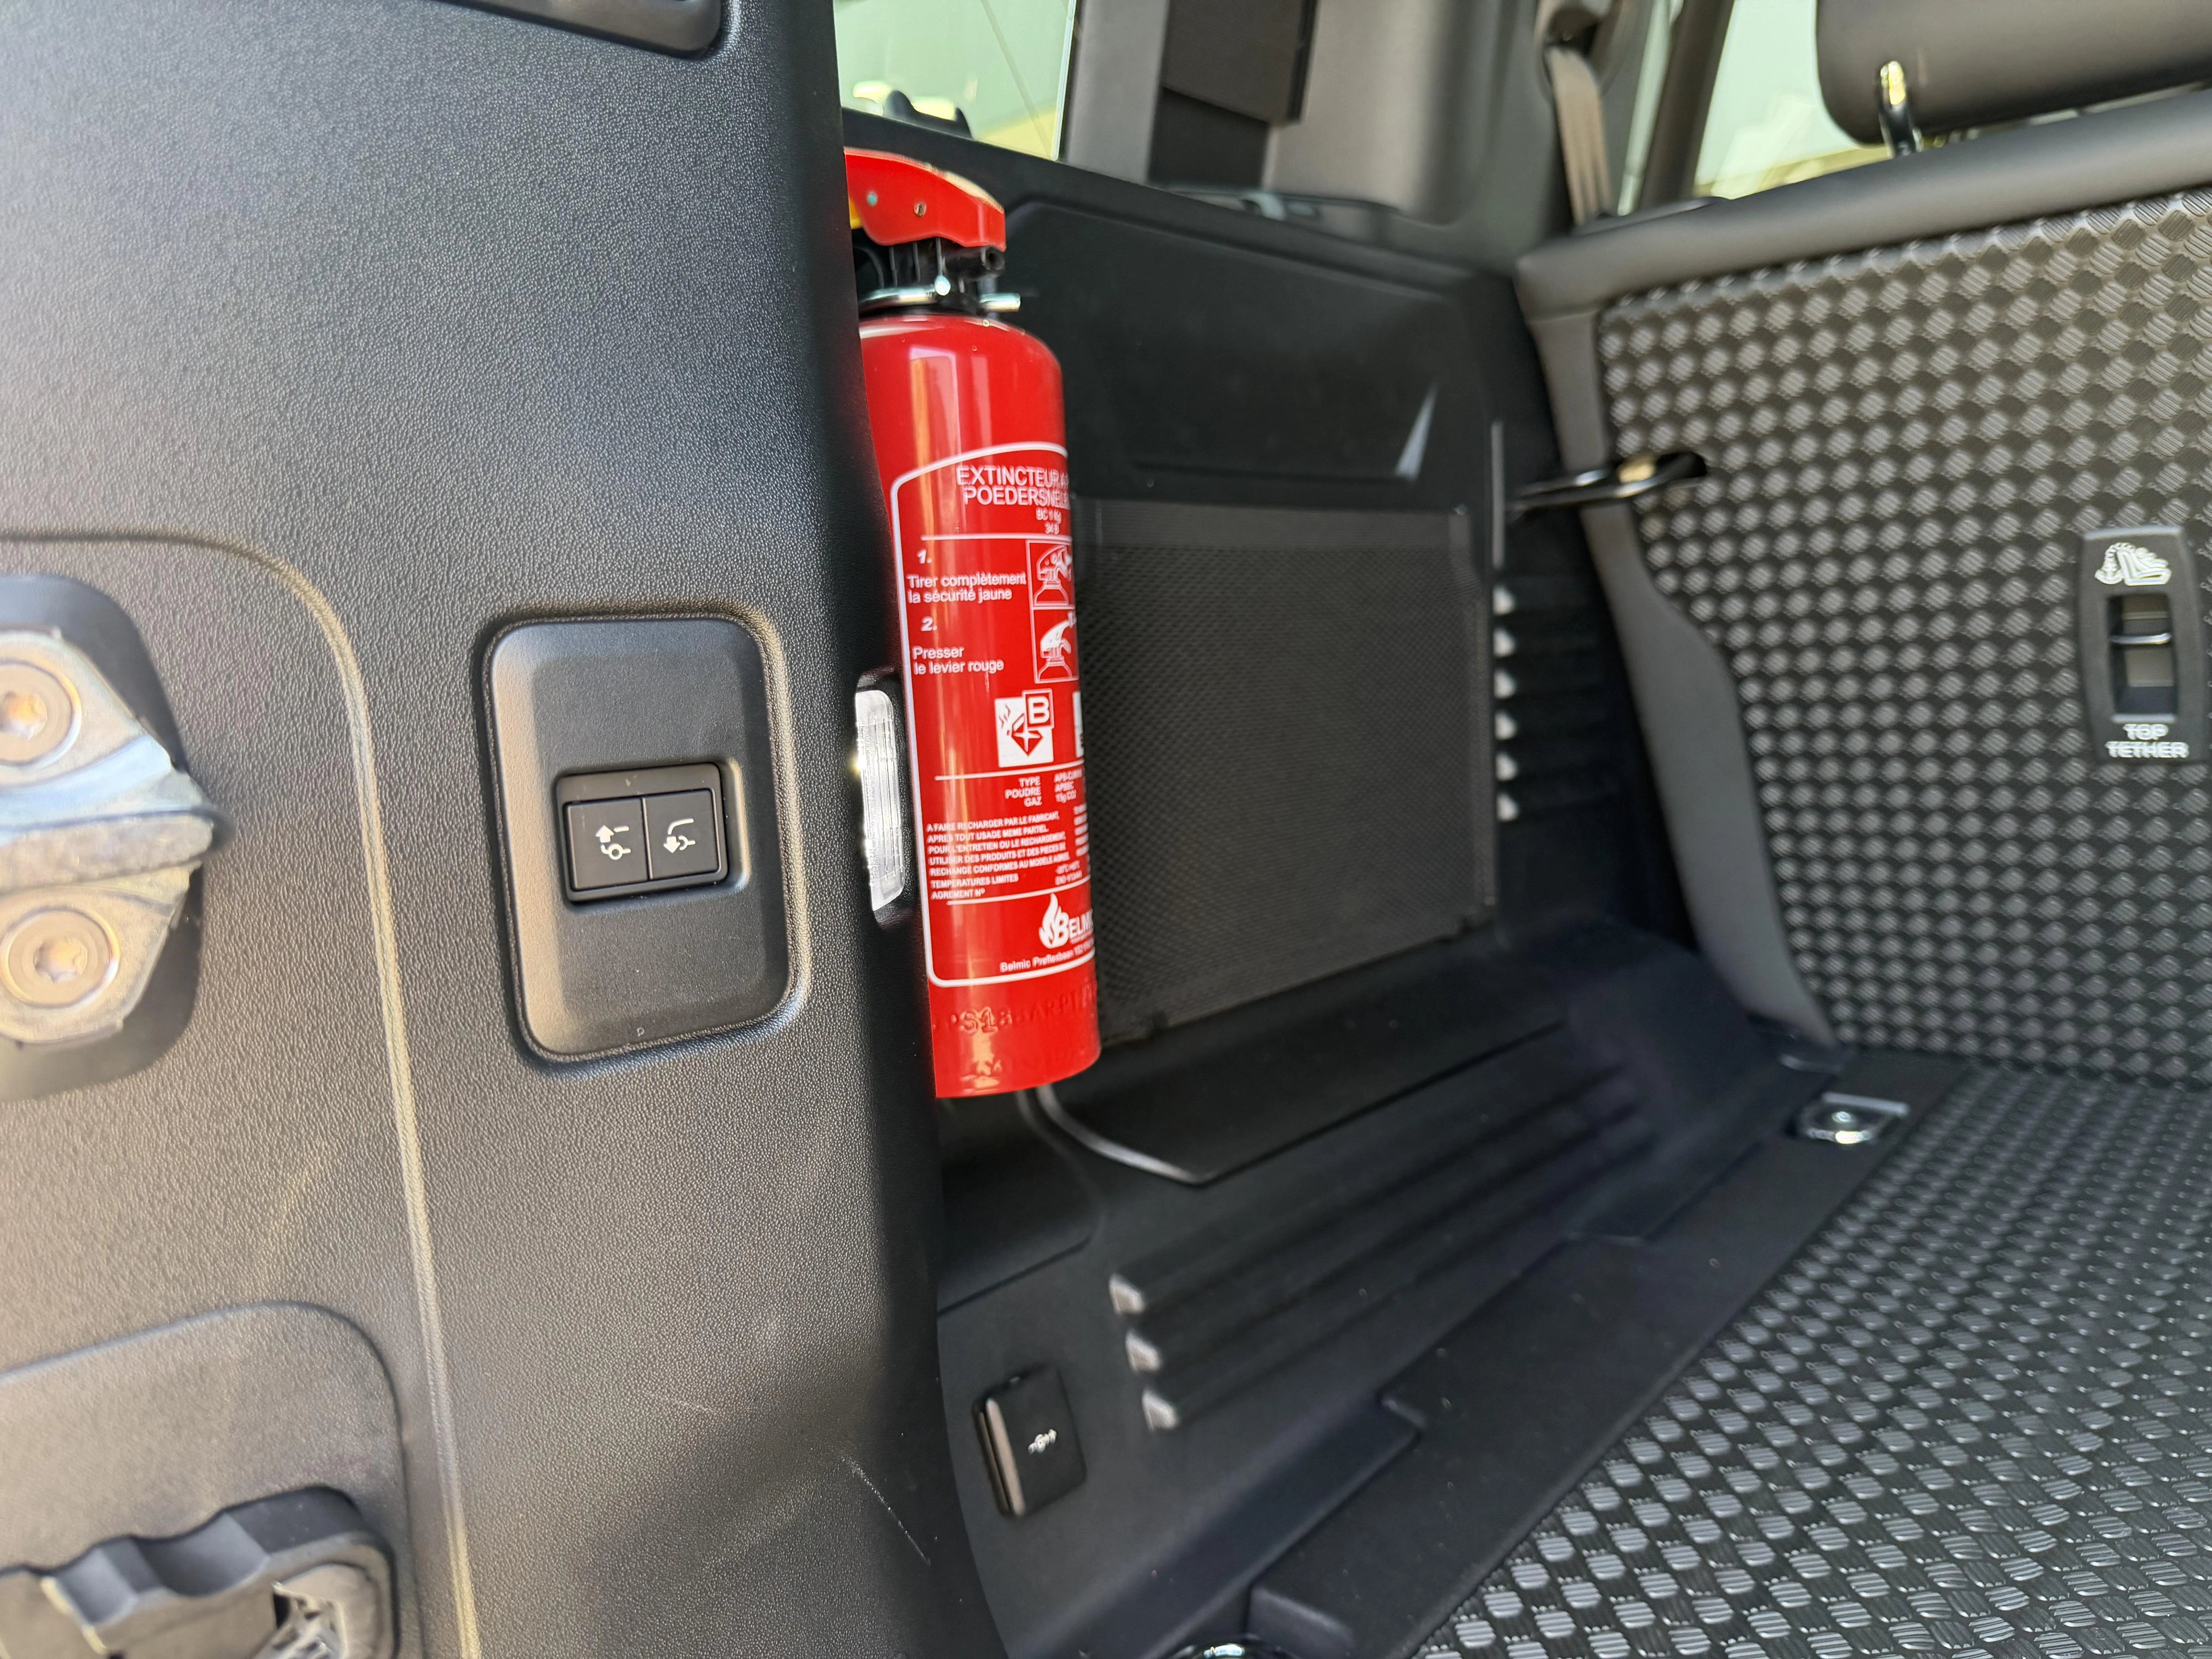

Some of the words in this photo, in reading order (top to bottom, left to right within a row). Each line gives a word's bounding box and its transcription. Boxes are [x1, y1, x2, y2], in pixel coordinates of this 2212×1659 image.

[956, 465, 1060, 488] EXTINCTEUR
[917, 548, 933, 564] 1.
[907, 574, 938, 588] Tirer
[941, 571, 1027, 589] complètement
[907, 591, 921, 603] la
[924, 587, 976, 603] sécurité
[978, 588, 1012, 604] jaune
[921, 617, 937, 631] 2.
[912, 646, 964, 660] Presser
[914, 662, 926, 675] le
[929, 661, 965, 673] levier
[968, 659, 1004, 674] rouge
[1028, 696, 1050, 725] B
[2123, 723, 2169, 740] TOP
[2105, 741, 2190, 758] TETHER
[1019, 776, 1041, 787] TYPE
[1005, 787, 1041, 799] POUDRE
[1024, 797, 1042, 807] GAZ
[926, 824, 933, 832] A
[934, 823, 956, 832] FAIRE
[958, 819, 1003, 831] RECHARGER
[1004, 817, 1018, 826] PAR
[1019, 816, 1027, 825] LE
[928, 834, 953, 843] APRES
[955, 833, 975, 842] TOUT
[976, 830, 1001, 840] USAGE
[1003, 828, 1022, 838] MEME
[1023, 824, 1049, 835] PARTIEL.
[928, 845, 949, 855] POUR
[953, 842, 998, 854] L'ENTRETIEN
[999, 840, 1010, 849] OU
[1011, 839, 1020, 848] LE
[929, 856, 963, 866] UTILISER
[965, 855, 980, 864] DES
[981, 851, 1017, 862] PRODUITS
[1017, 849, 1026, 858] ET
[1026, 848, 1040, 857] DES
[930, 866, 972, 876] RECHANGE
[973, 862, 1018, 874] CONFORMES
[1018, 860, 1029, 869] AU
[931, 878, 991, 889] TEMPERATURES
[991, 874, 1019, 885] LIMITES
[931, 890, 973, 900] AGREMENT
